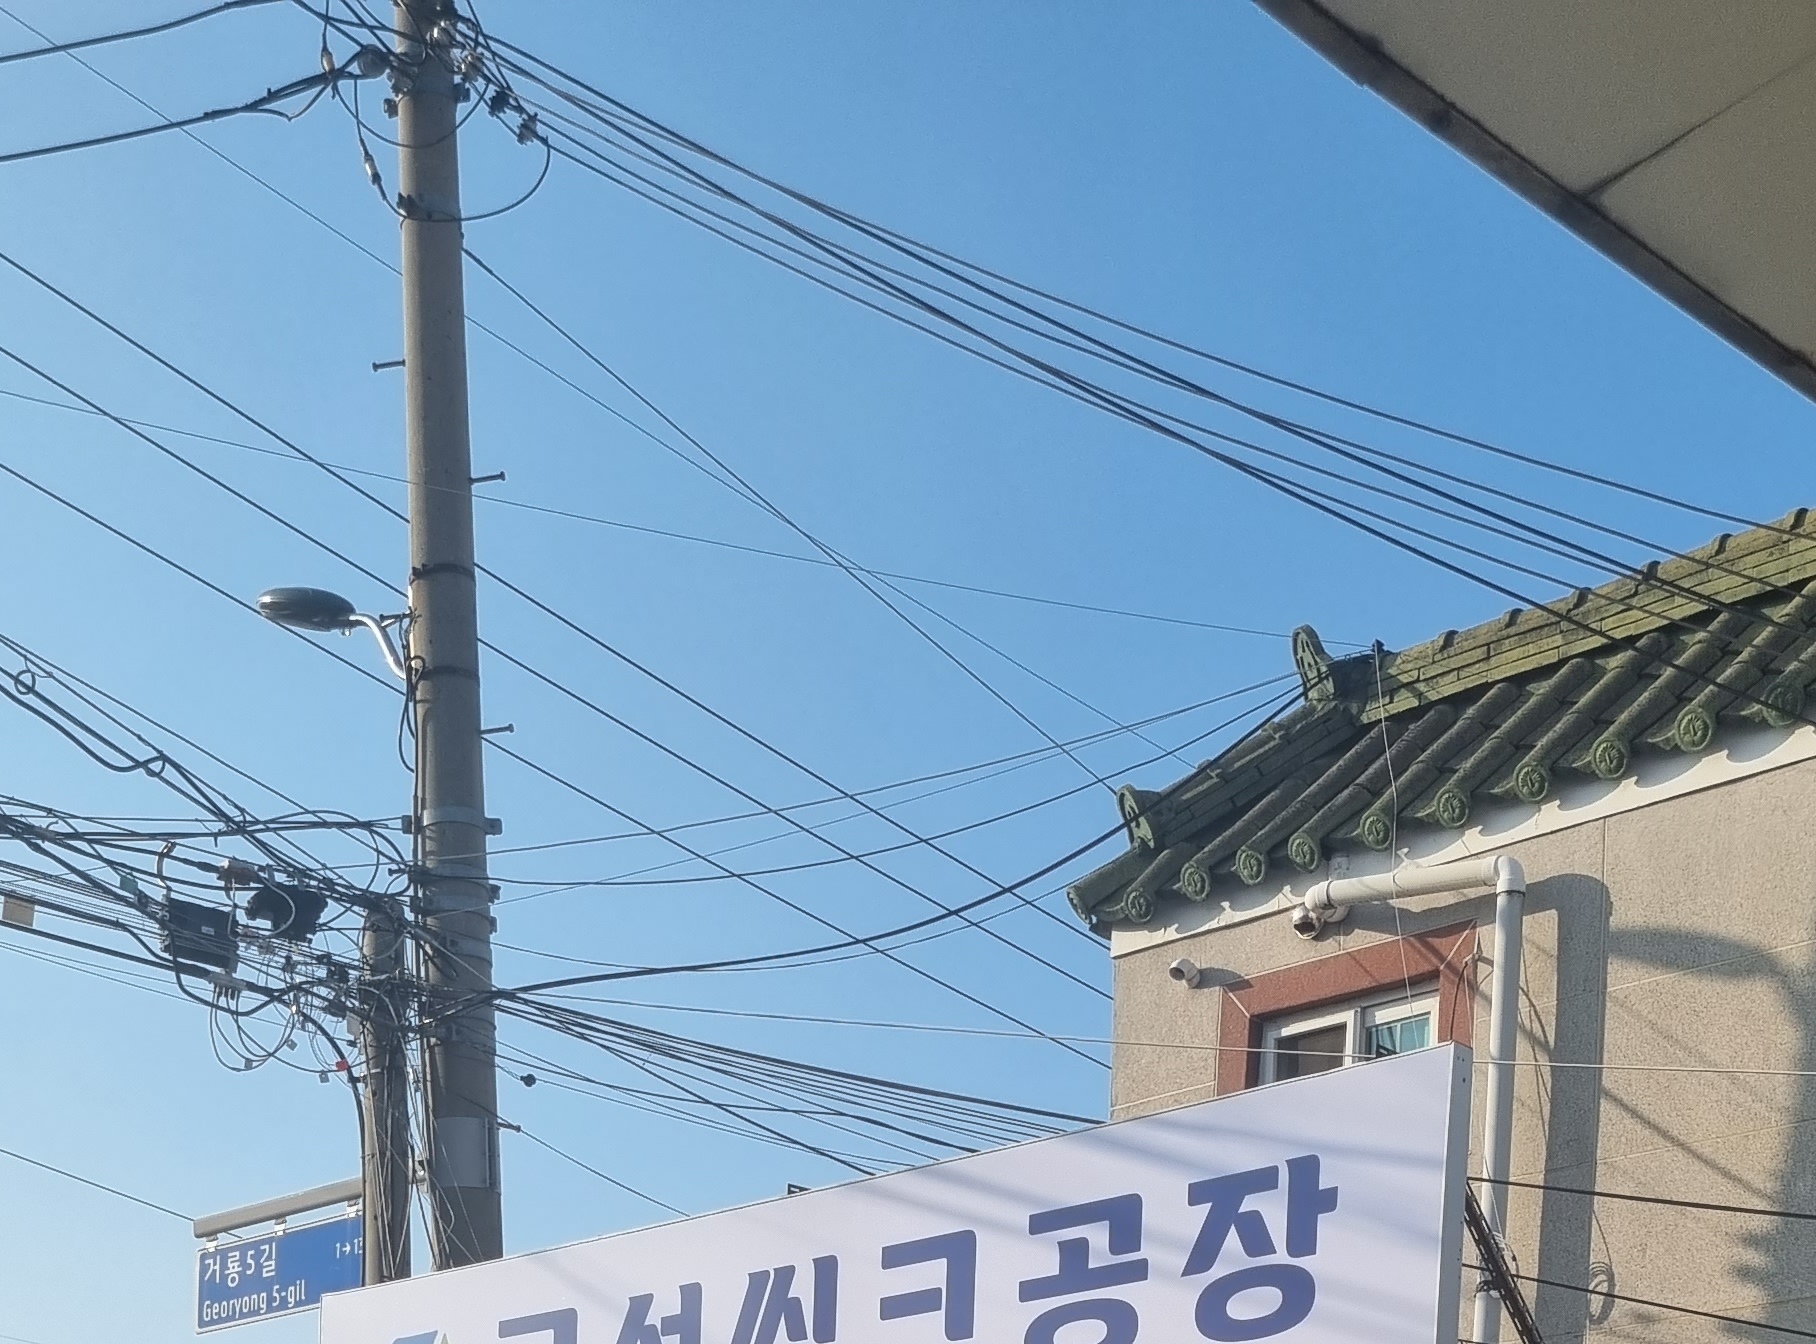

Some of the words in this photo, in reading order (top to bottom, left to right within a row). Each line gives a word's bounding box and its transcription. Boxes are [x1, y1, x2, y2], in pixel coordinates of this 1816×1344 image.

[204, 1242, 277, 1288] 거룡5길
[203, 1293, 267, 1321] Georyong
[272, 1280, 306, 1308] 5-gil
